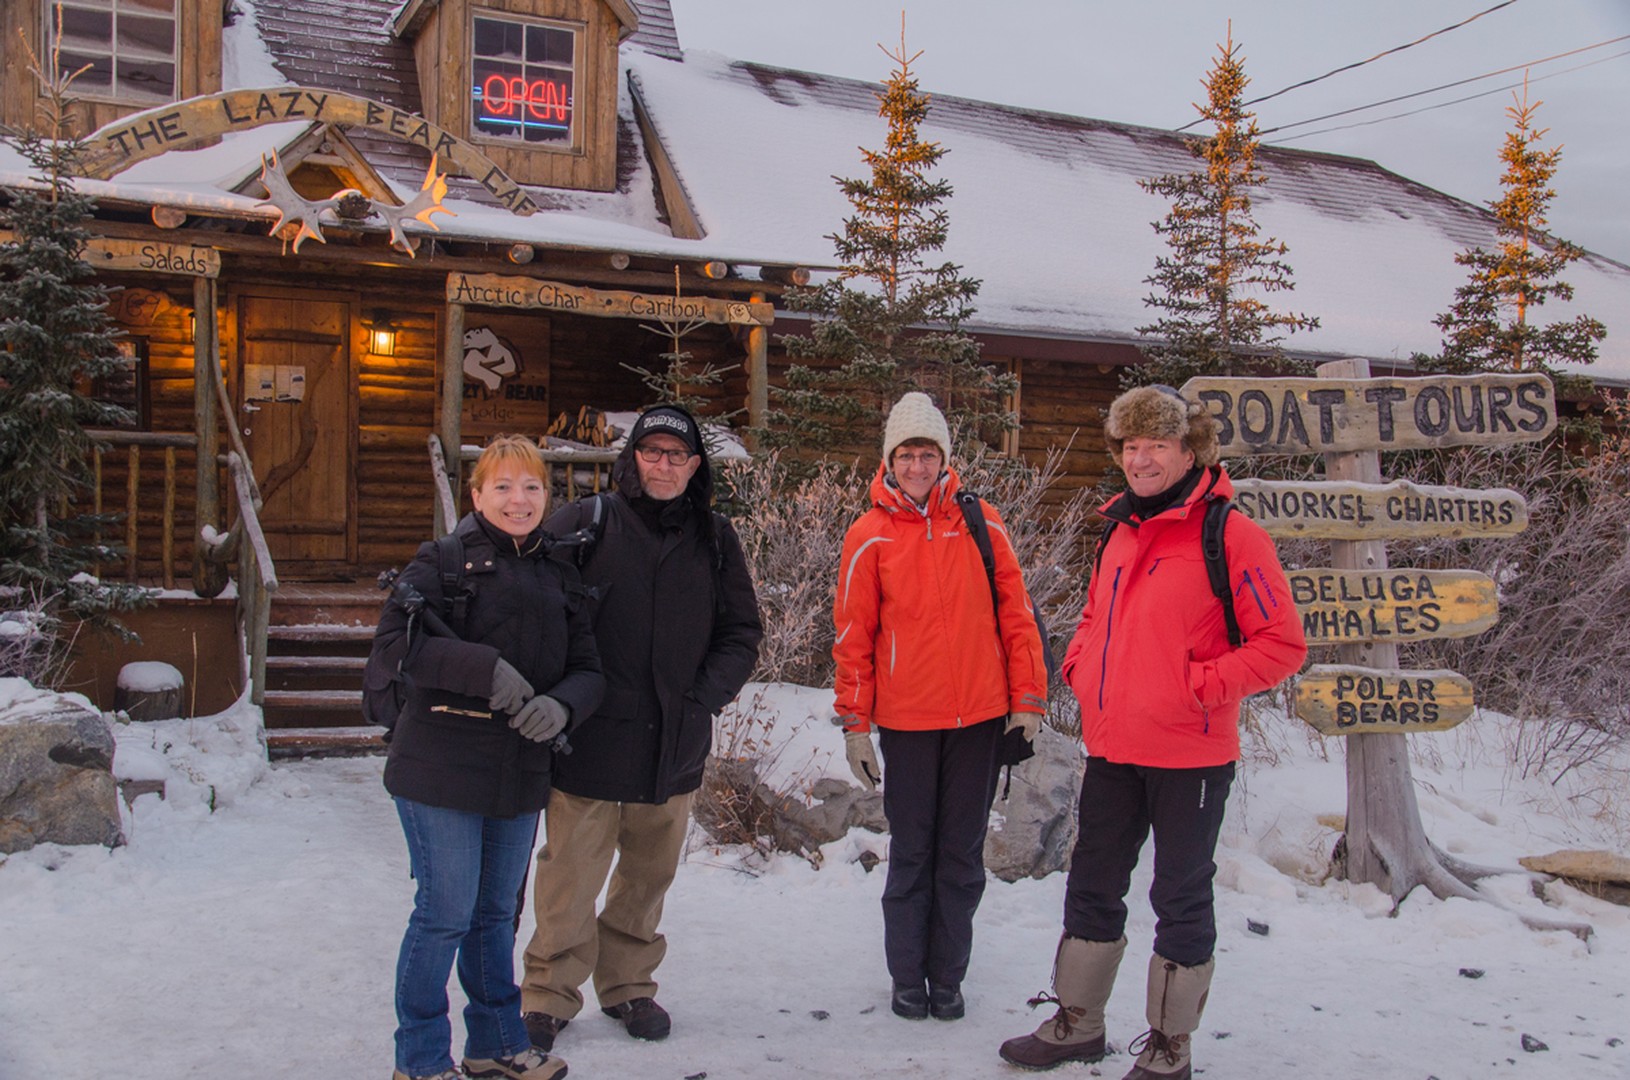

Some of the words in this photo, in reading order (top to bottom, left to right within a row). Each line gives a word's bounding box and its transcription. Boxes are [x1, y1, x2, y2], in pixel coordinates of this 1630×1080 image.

[484, 74, 567, 121] OPEN
[107, 112, 187, 157] THE
[222, 91, 328, 123] LAZY
[365, 101, 457, 159] BEAR
[481, 166, 543, 213] CAF
[139, 245, 207, 274] Salads
[452, 274, 522, 303] Arctic
[537, 284, 585, 310] Char
[629, 296, 706, 319] Caribou
[505, 383, 547, 400] BEAR
[471, 404, 514, 422] Lodge
[1198, 388, 1346, 447] BOAT
[1365, 382, 1549, 442] TOURS
[1238, 490, 1374, 523] SNORKEL
[1386, 494, 1514, 525] CHARTERS
[1290, 574, 1437, 604] BELUGA
[1303, 602, 1441, 638] WHALES
[1336, 675, 1436, 702] POLAR
[1336, 701, 1440, 728] BEARS
